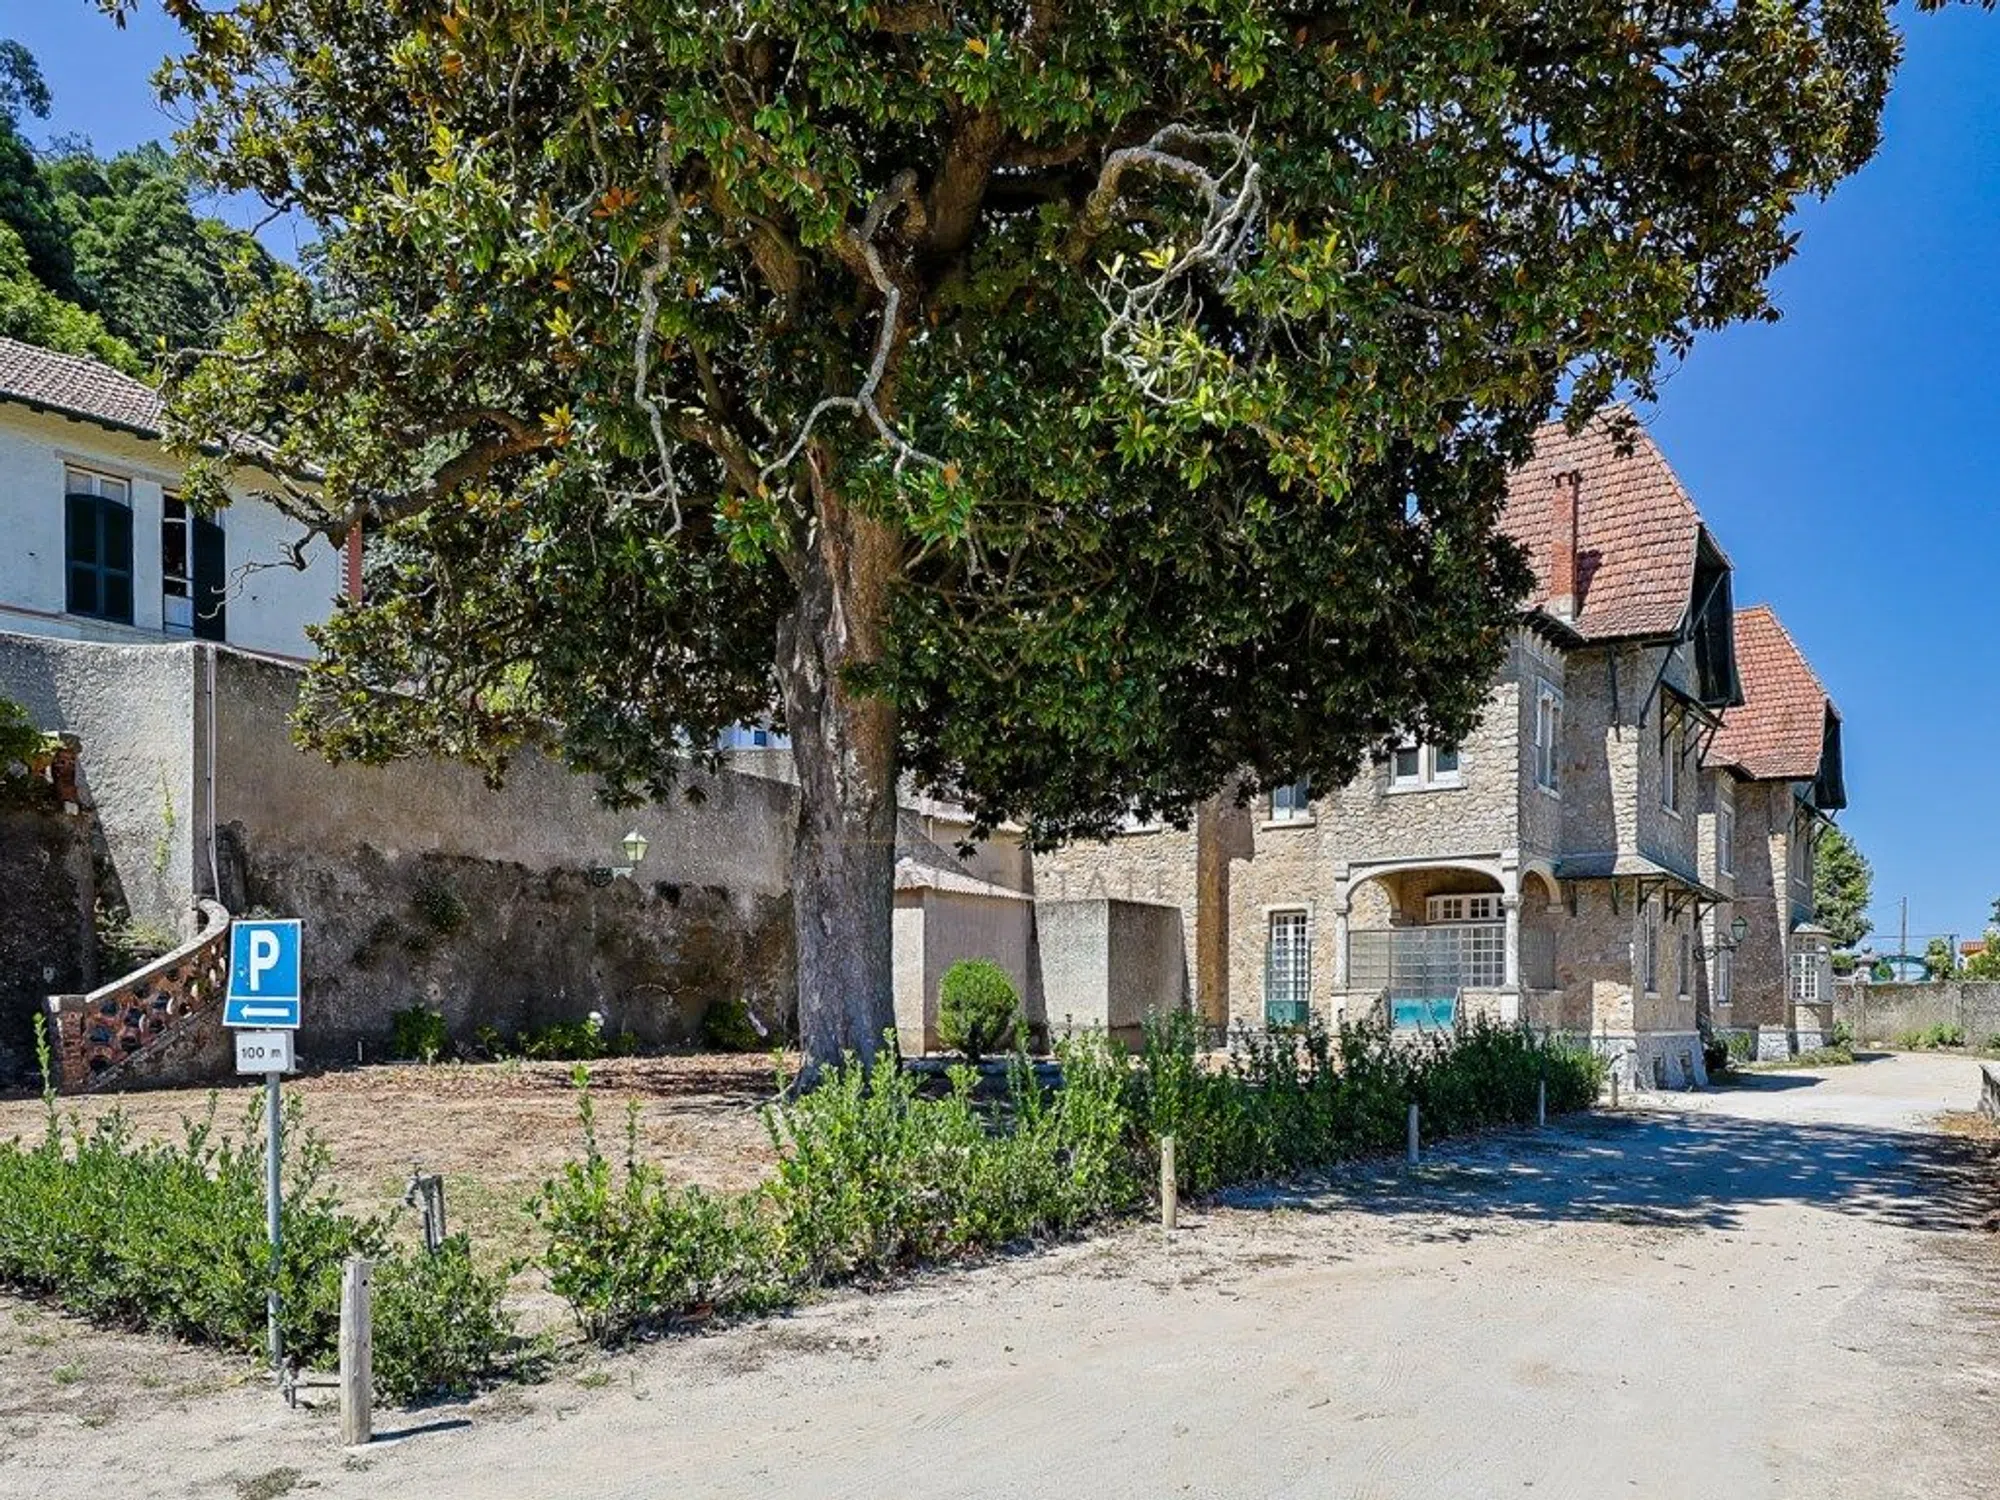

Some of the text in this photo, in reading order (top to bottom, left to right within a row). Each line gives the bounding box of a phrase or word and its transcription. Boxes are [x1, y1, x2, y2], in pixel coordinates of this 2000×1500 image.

[250, 930, 280, 991] P
[241, 1046, 282, 1059] 100 m
